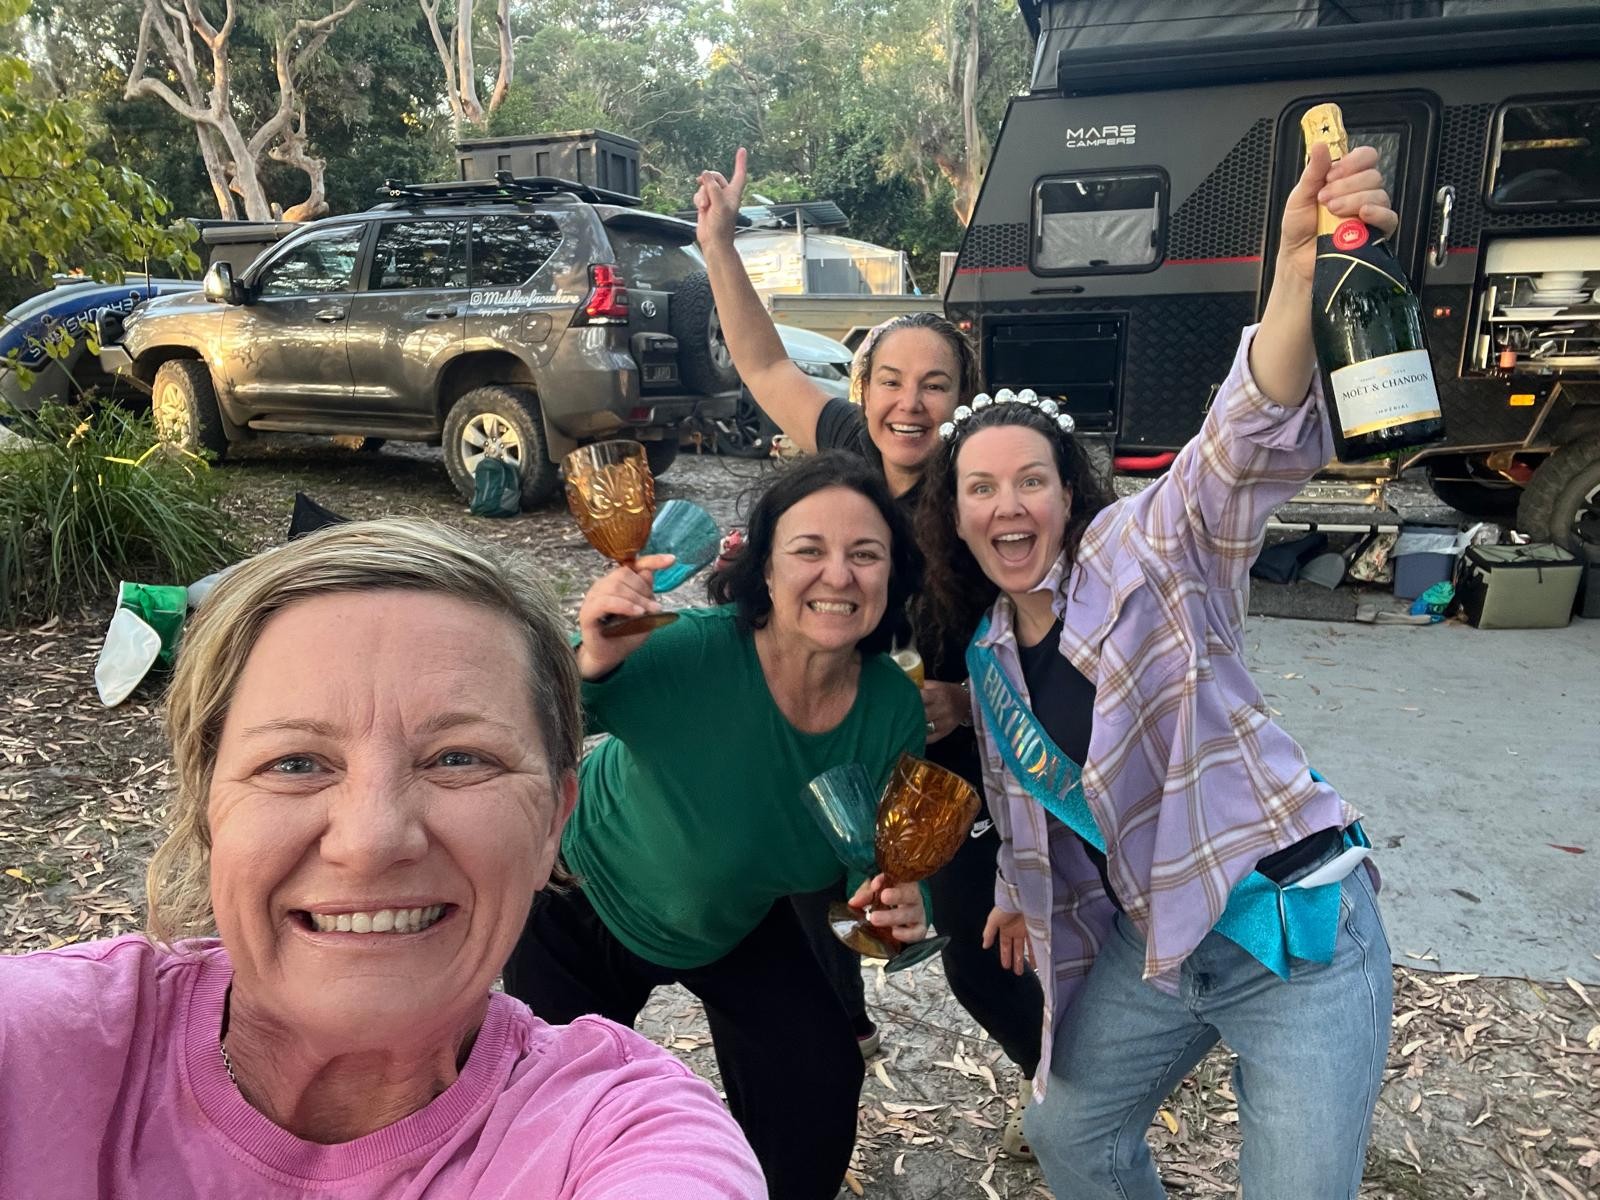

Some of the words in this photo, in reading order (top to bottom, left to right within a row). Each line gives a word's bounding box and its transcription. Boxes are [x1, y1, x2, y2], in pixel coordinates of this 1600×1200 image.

[1066, 124, 1136, 140] MARS
[1066, 137, 1136, 148] CAMPERS
[1381, 372, 1429, 390] CHANDON
